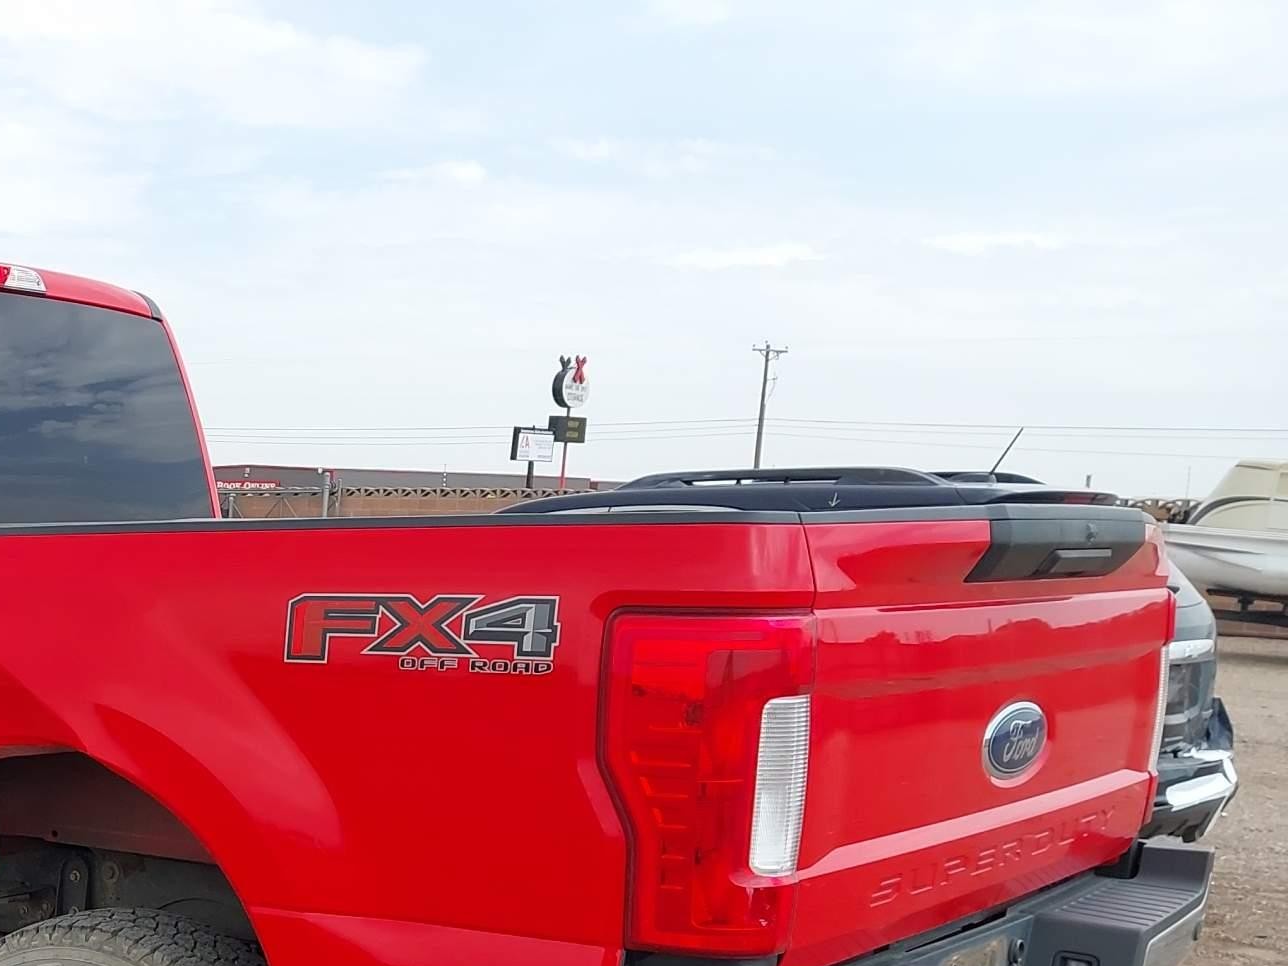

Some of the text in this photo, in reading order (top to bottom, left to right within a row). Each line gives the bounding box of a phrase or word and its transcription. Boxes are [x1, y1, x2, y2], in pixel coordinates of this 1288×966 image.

[284, 593, 561, 664] FX4
[398, 657, 553, 675] OFF ROAD
[1003, 719, 1040, 764] Ford
[869, 804, 1117, 908] SUPER DUTY
